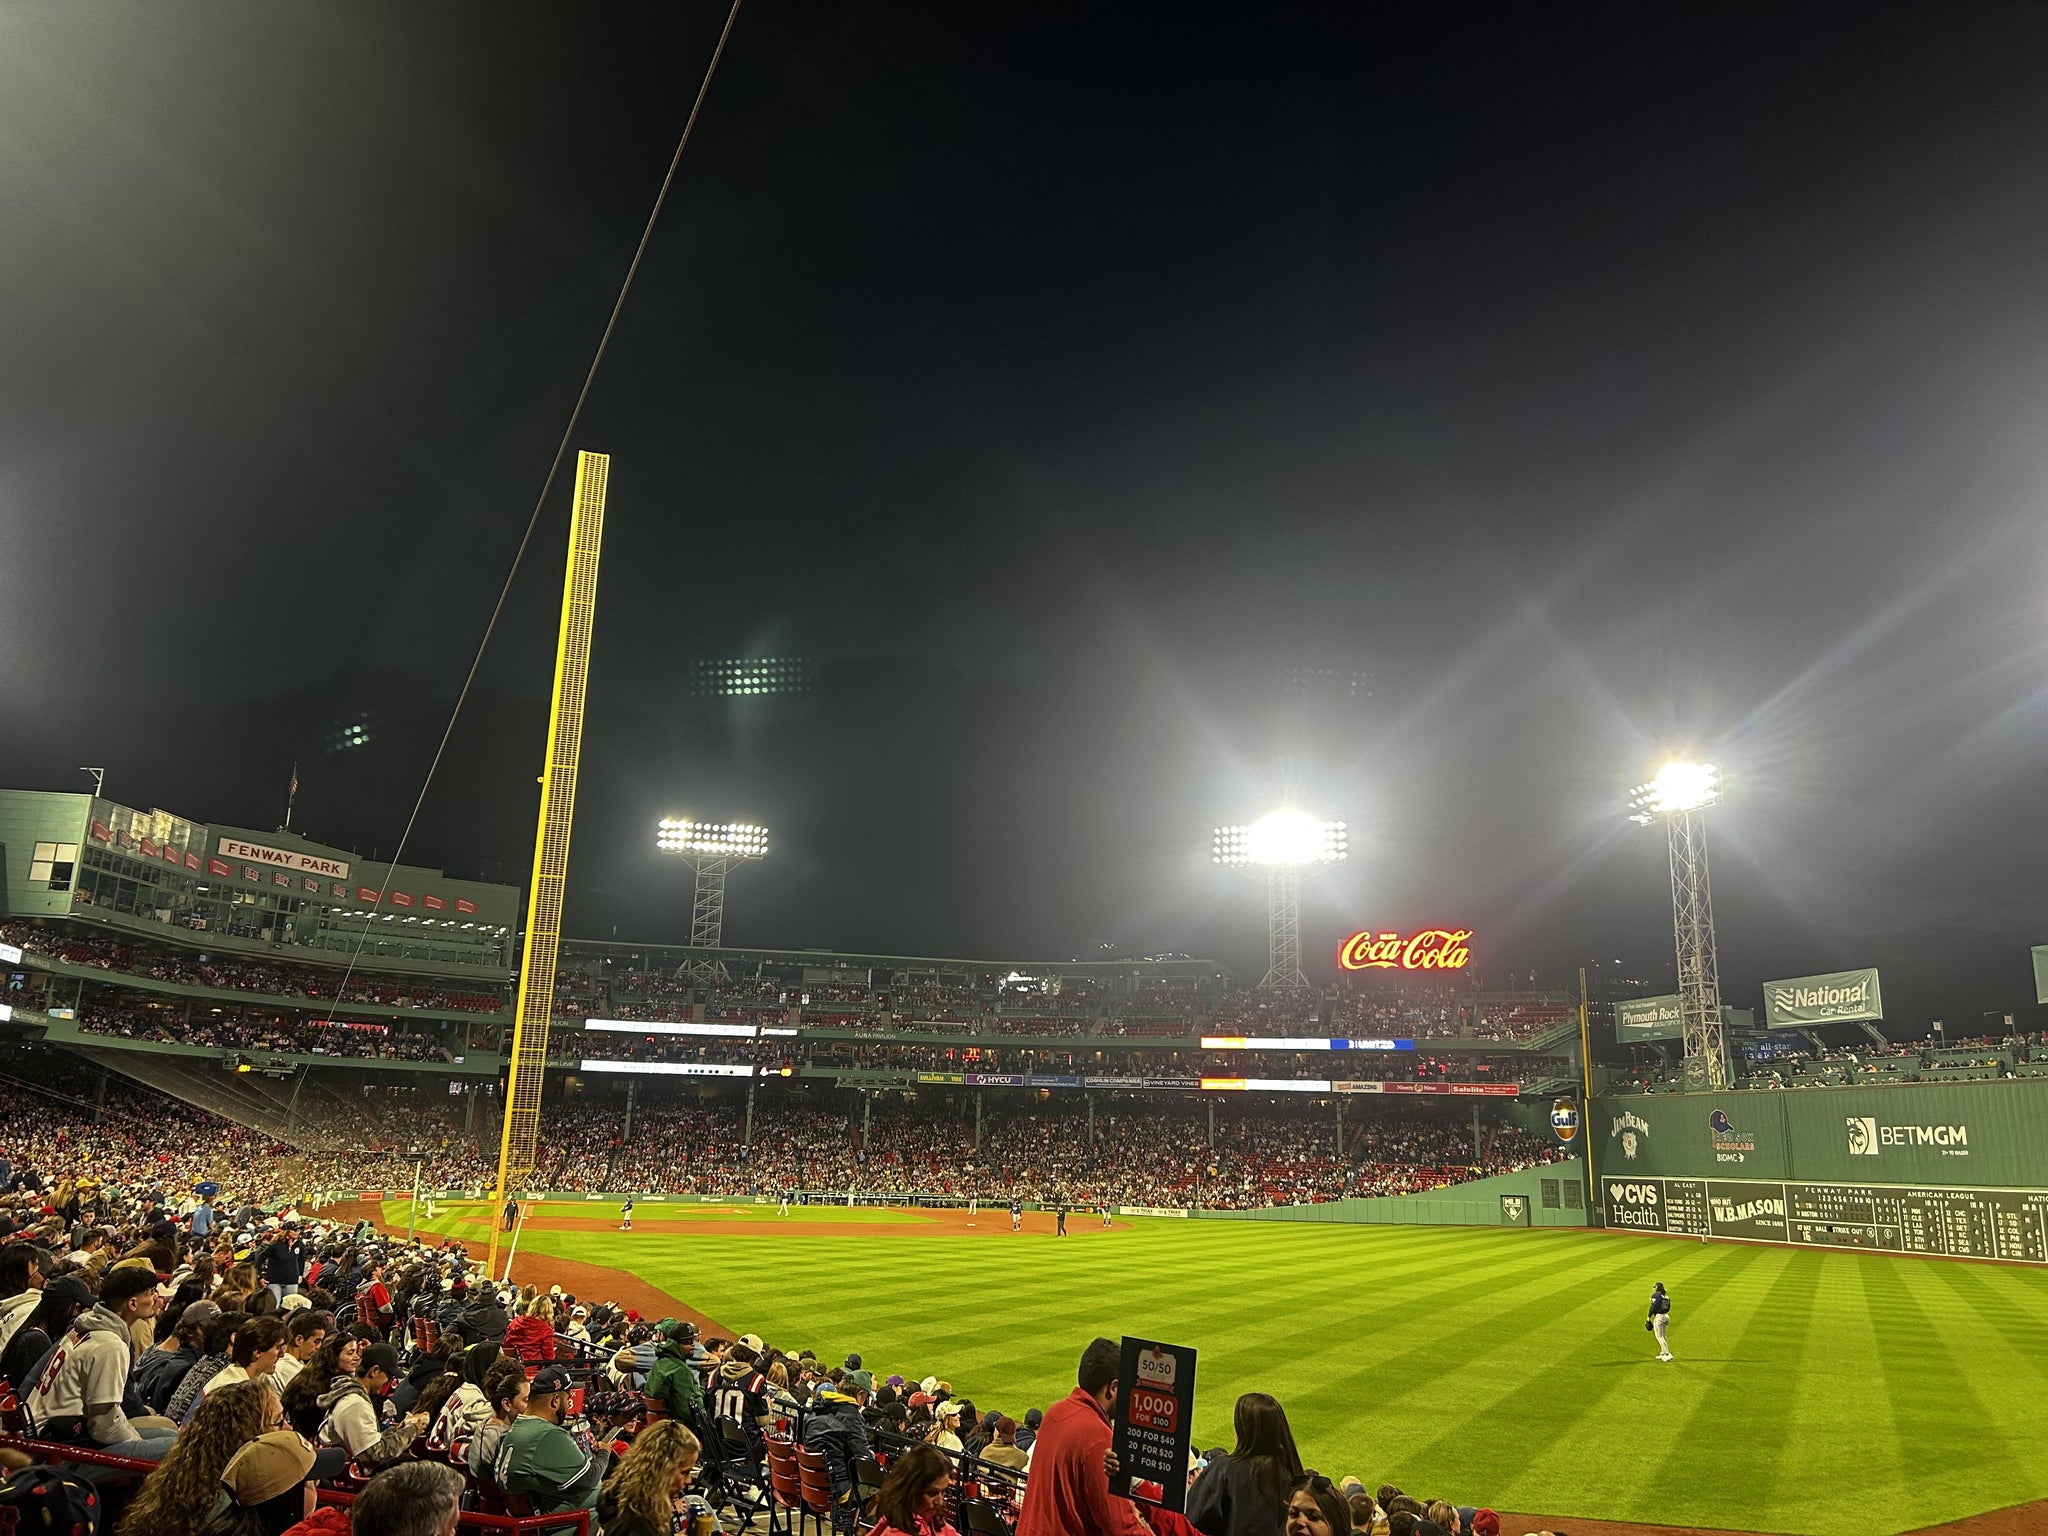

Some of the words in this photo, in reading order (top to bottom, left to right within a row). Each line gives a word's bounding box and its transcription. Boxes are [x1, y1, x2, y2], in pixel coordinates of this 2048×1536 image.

[228, 843, 293, 864] FENWAY
[301, 857, 340, 874] PARK
[1341, 930, 1473, 970] Coca-Cola
[1795, 980, 1867, 1008] National
[1622, 1009, 1658, 1025] Plymouth
[1660, 1006, 1680, 1020] Rock
[1820, 1007, 1835, 1016] Car
[1837, 1004, 1866, 1014] Rental
[1552, 1112, 1577, 1126] Gulf
[1611, 1116, 1626, 1138] JIM
[1625, 1111, 1650, 1138] BEAM
[1716, 1133, 1733, 1142] RED
[1735, 1133, 1754, 1142] SOX
[1880, 1126, 1968, 1145] BETMGM
[1716, 1142, 1755, 1150] SCHOLARS
[1717, 1153, 1738, 1162] BIDMC
[1625, 1184, 1657, 1204] CVS
[1613, 1205, 1660, 1226] Health
[1833, 1226, 1850, 1234] STRIKE
[1142, 1360, 1171, 1375] 50/50
[715, 1389, 745, 1425] 10
[1134, 1393, 1174, 1416] 1,000
[1135, 1413, 1150, 1423] FOR
[1152, 1416, 1169, 1427] $100
[1127, 1427, 1142, 1438] 200
[1143, 1432, 1159, 1443] FOR
[1160, 1435, 1175, 1446] $40
[1128, 1440, 1138, 1450] 20
[1142, 1444, 1158, 1455] FOR
[1159, 1448, 1174, 1459] $20
[1129, 1454, 1135, 1462] 3
[1141, 1457, 1157, 1468] FOR
[1158, 1460, 1171, 1472] $10
